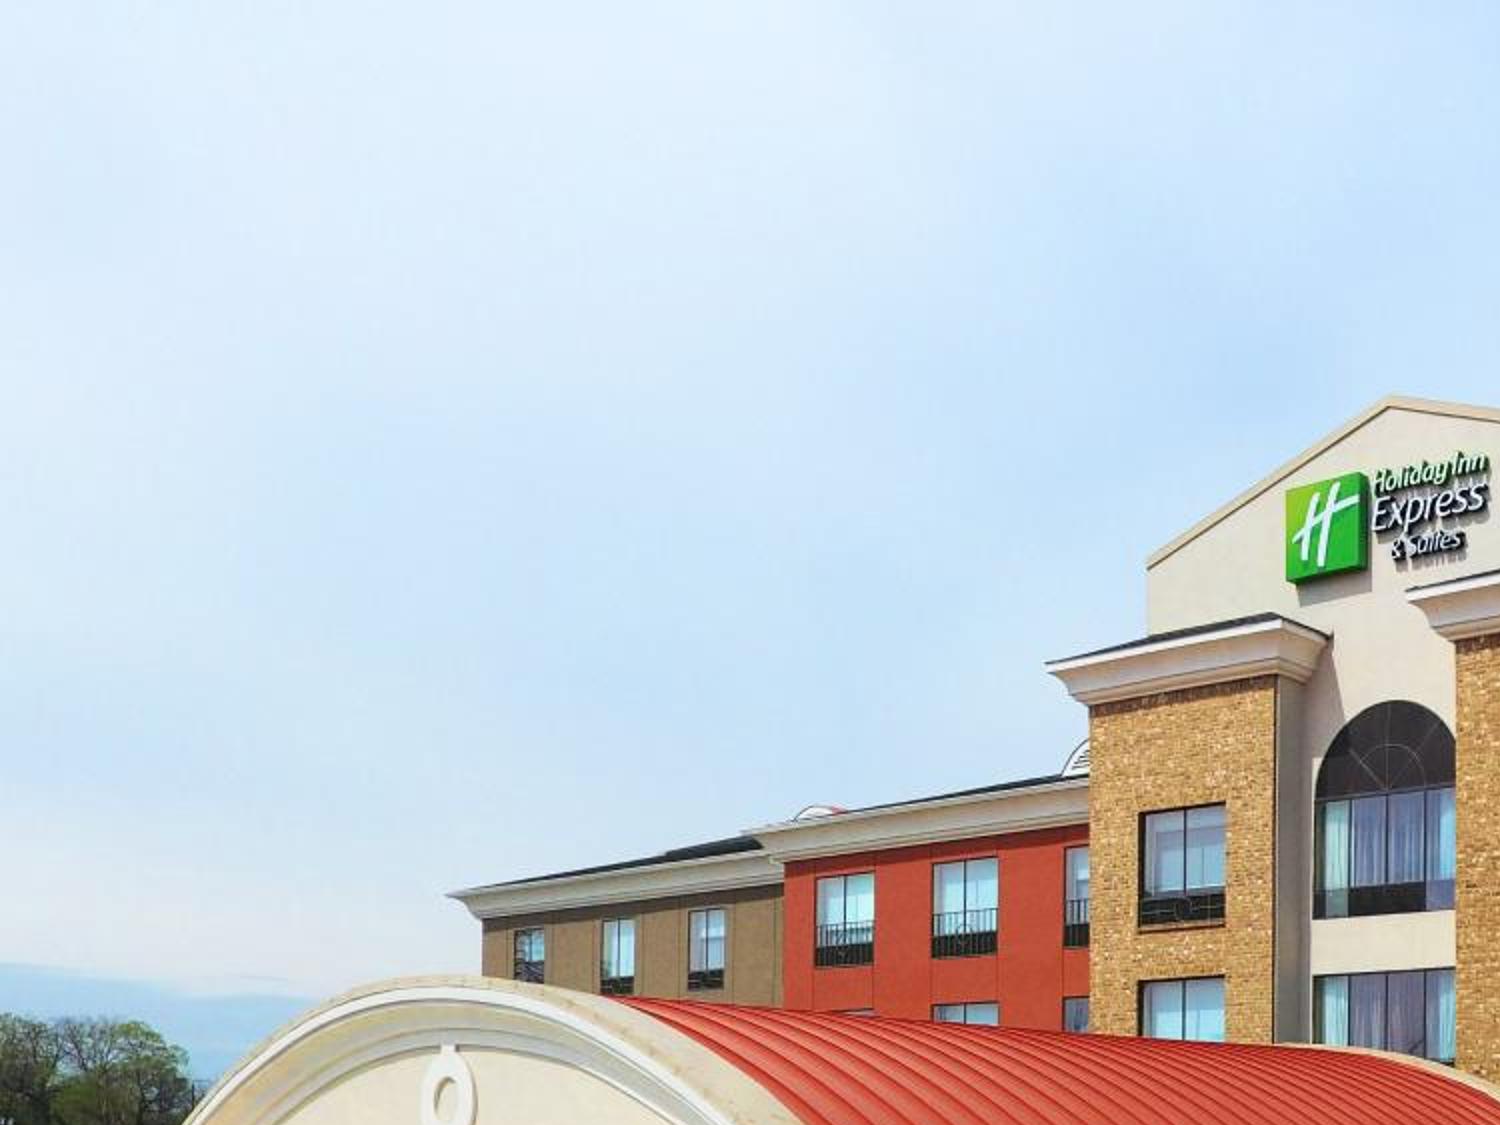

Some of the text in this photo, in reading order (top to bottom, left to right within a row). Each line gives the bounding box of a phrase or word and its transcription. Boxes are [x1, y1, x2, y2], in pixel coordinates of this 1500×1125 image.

[1371, 450, 1488, 498] Holiday Inn
[1371, 481, 1487, 534] Express
[1391, 528, 1464, 560] & Suites
